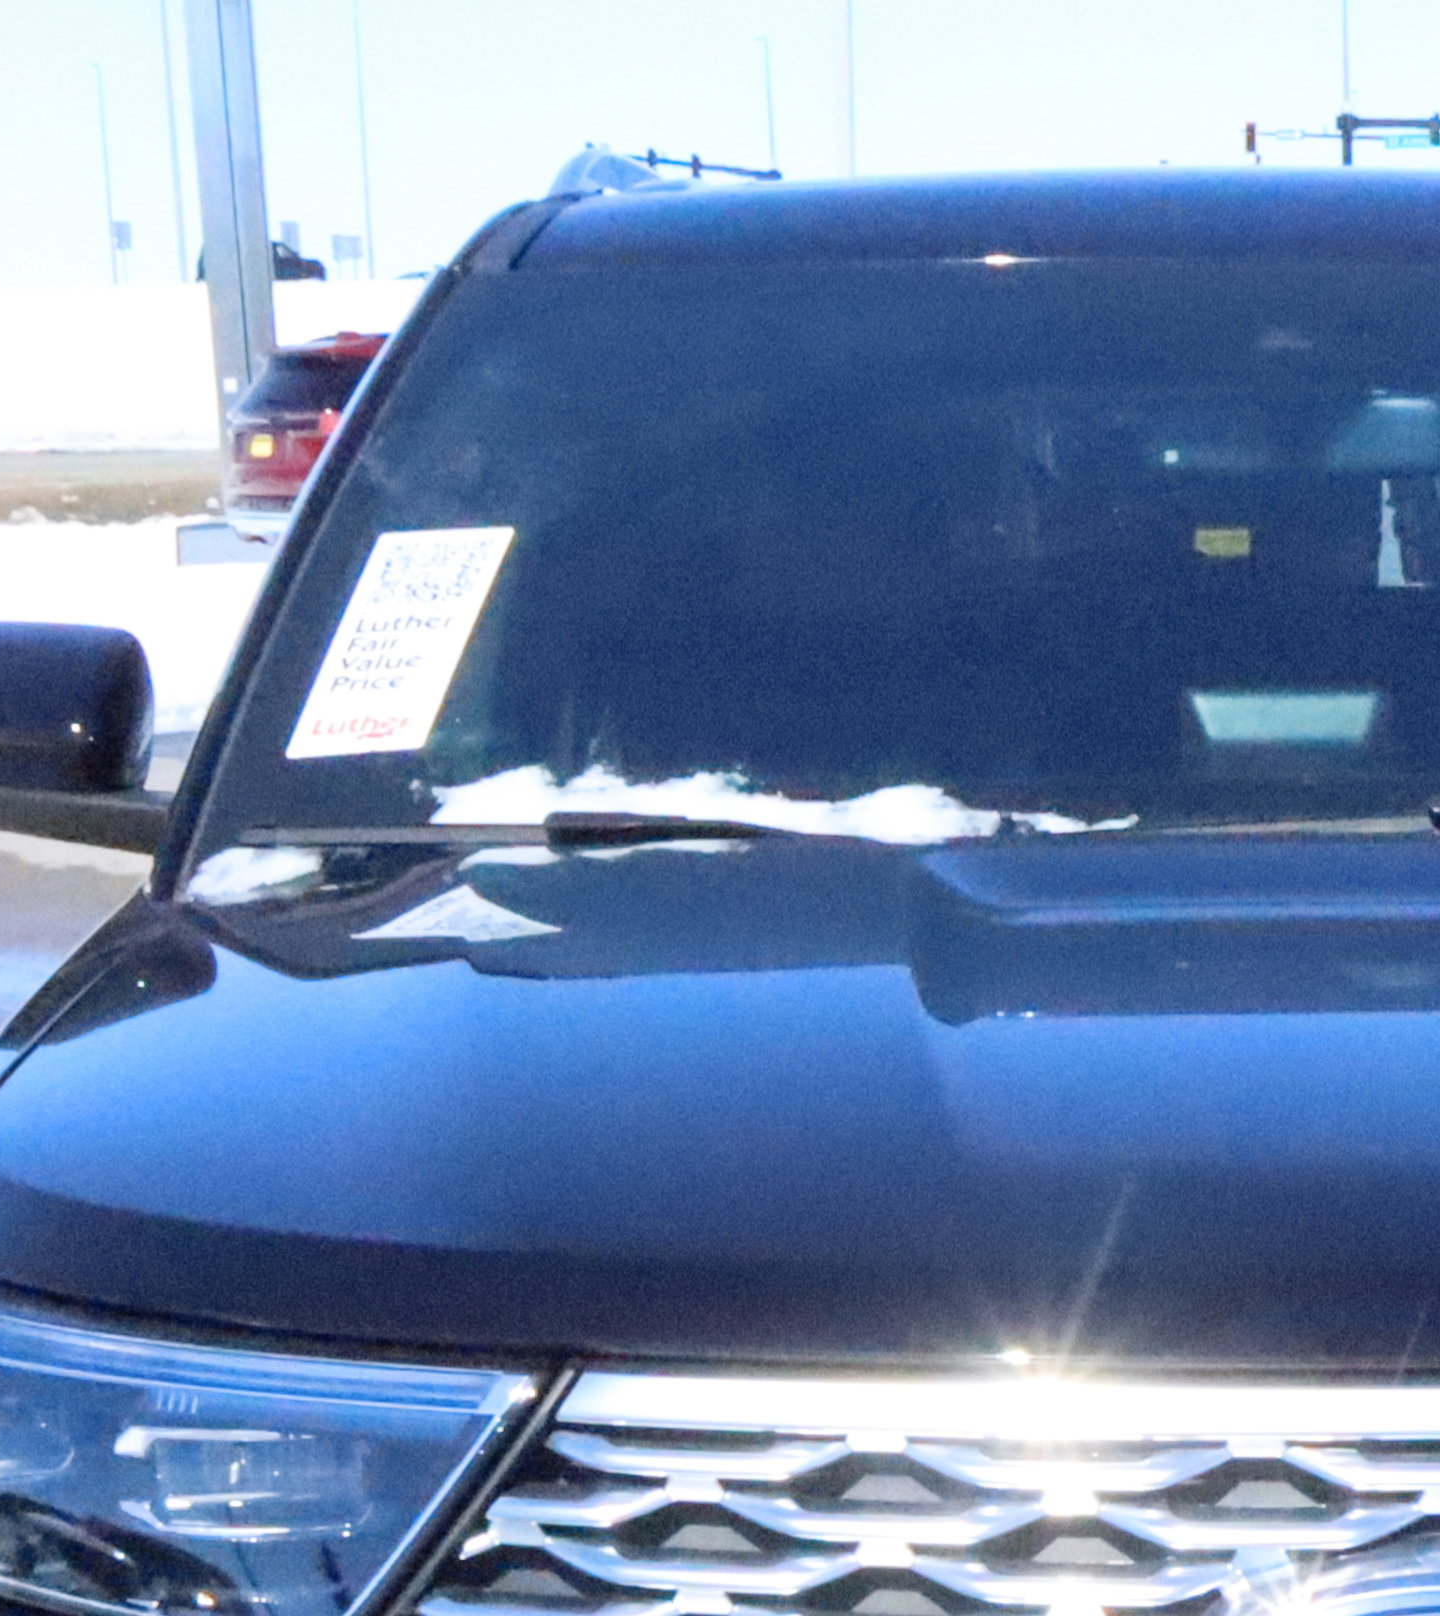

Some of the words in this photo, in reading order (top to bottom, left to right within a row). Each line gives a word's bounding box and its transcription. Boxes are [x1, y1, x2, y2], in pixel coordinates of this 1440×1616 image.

[355, 615, 454, 634] Luther
[347, 637, 400, 653] Fair
[342, 654, 422, 672] Value
[330, 675, 405, 693] Price
[312, 716, 410, 737] Luther
